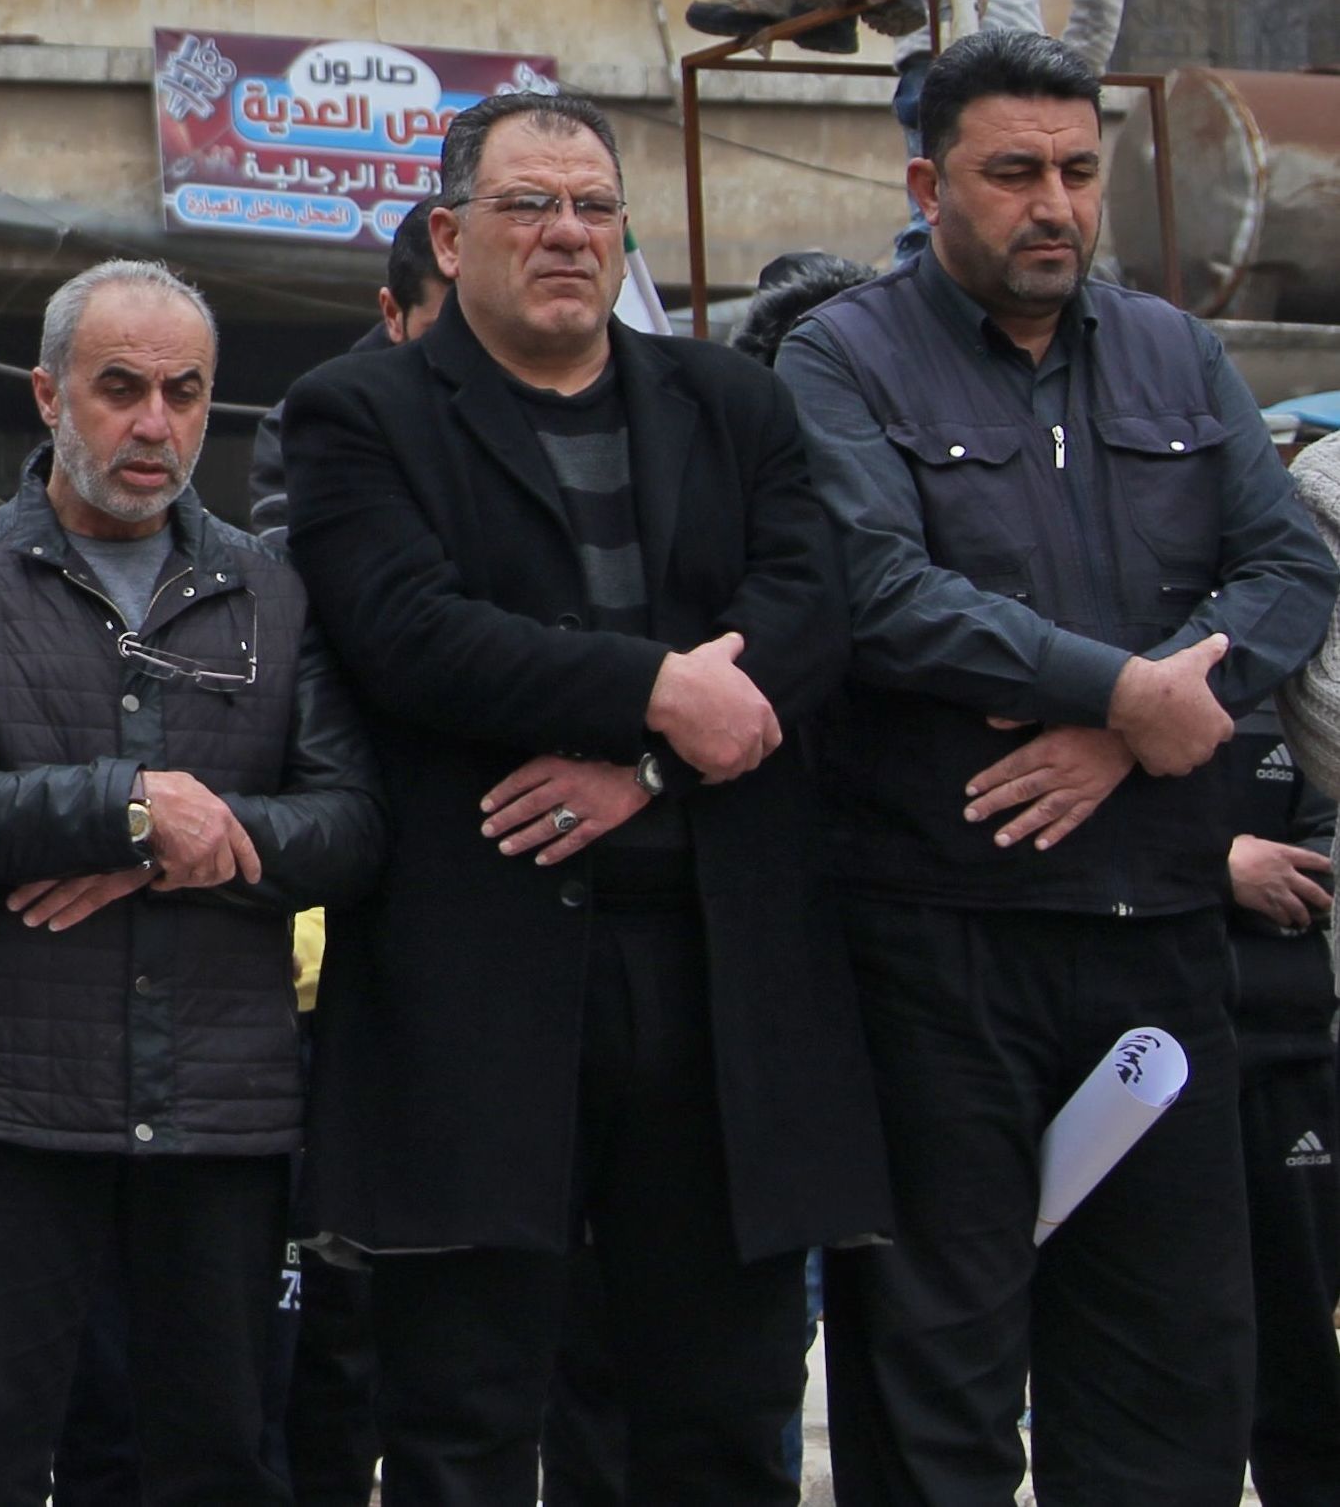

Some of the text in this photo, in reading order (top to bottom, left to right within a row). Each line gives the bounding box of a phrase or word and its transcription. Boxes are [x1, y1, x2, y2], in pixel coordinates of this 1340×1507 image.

[309, 53, 418, 86] صالون
[243, 82, 370, 135] العدية
[244, 152, 376, 194] الرجالية
[1255, 768, 1295, 782] adida
